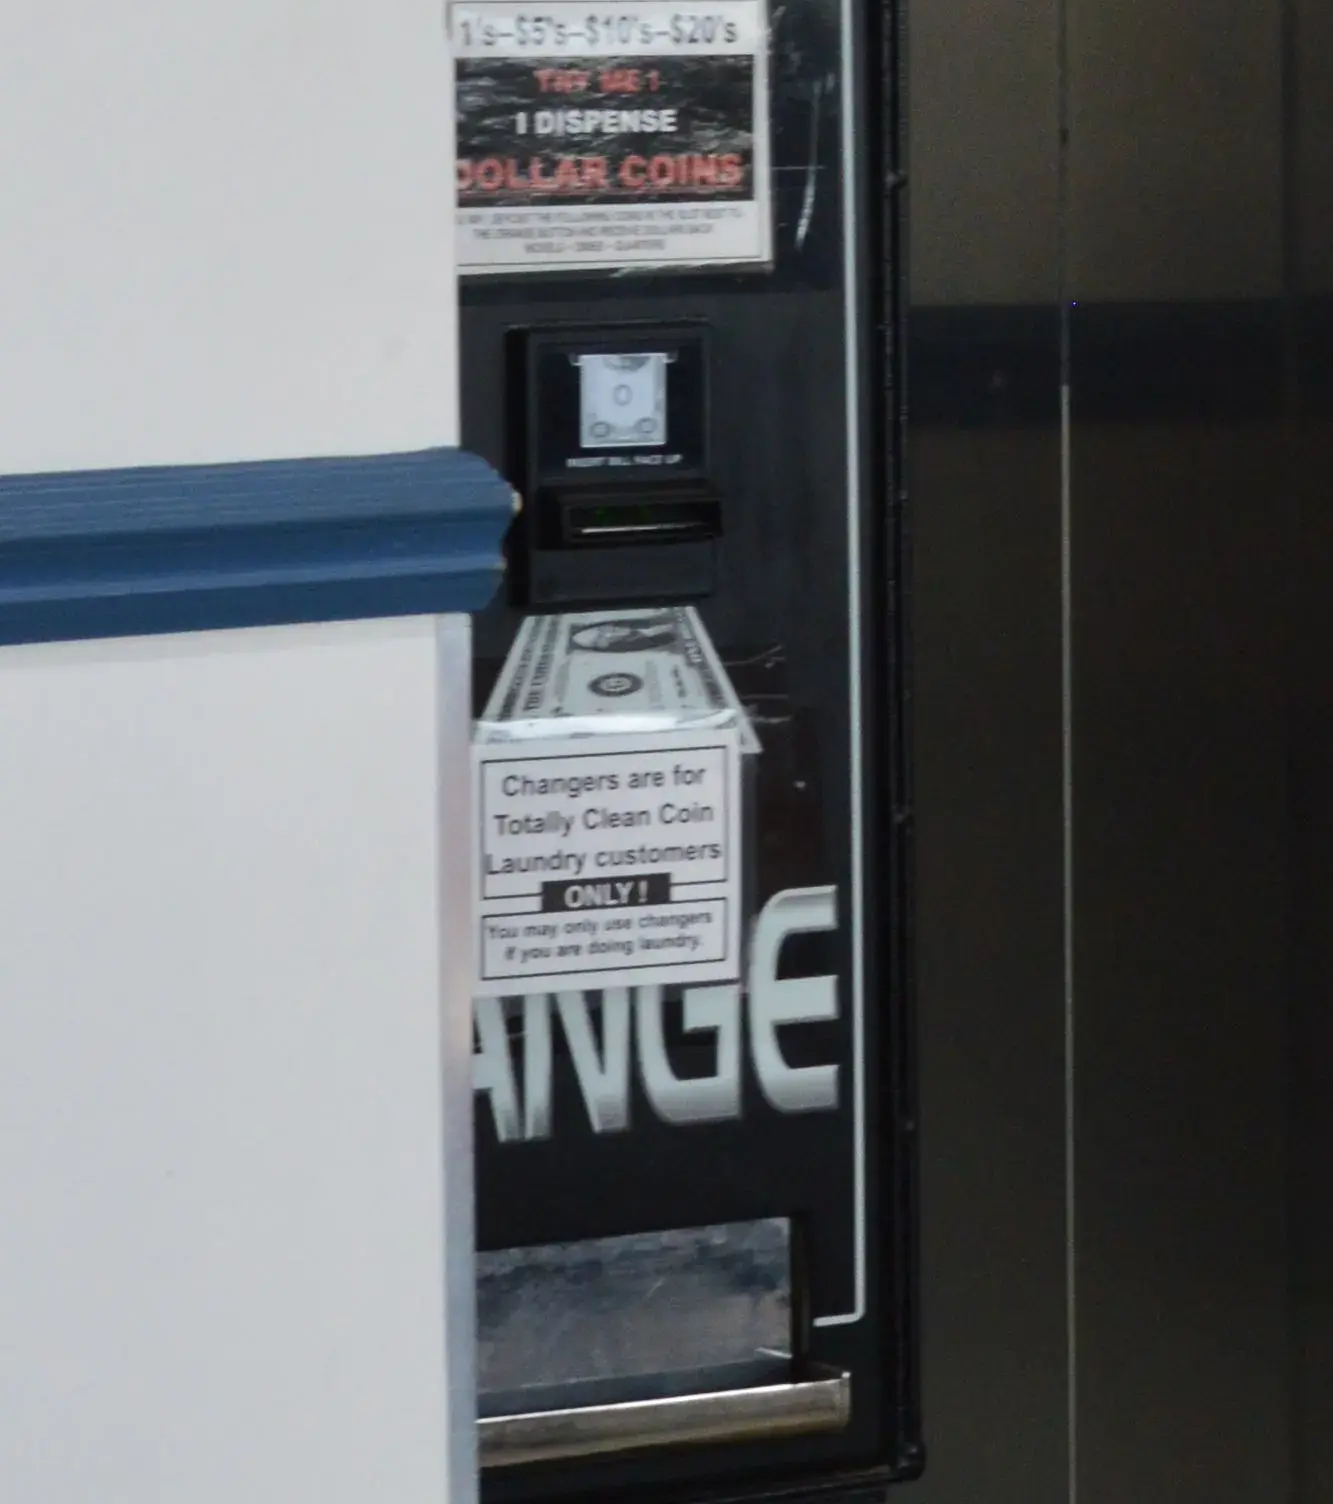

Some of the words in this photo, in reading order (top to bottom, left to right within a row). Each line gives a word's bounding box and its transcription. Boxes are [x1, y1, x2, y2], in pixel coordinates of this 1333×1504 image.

[532, 108, 679, 136] DISPENSE
[456, 155, 609, 192] DOLLAR
[617, 153, 744, 190] COINS
[501, 773, 620, 798] Changers
[627, 771, 665, 789] are
[671, 765, 706, 786] for
[493, 810, 575, 837] Totally
[582, 807, 651, 830] Clean
[658, 802, 714, 824] Coin
[484, 849, 587, 875] Laundry
[594, 842, 722, 868] customers
[488, 923, 518, 940] You
[523, 921, 557, 939] may
[563, 917, 598, 937] only
[604, 916, 632, 930] use
[638, 910, 713, 931] changers
[519, 945, 551, 963] you
[556, 943, 582, 957] are
[587, 938, 635, 956] doing
